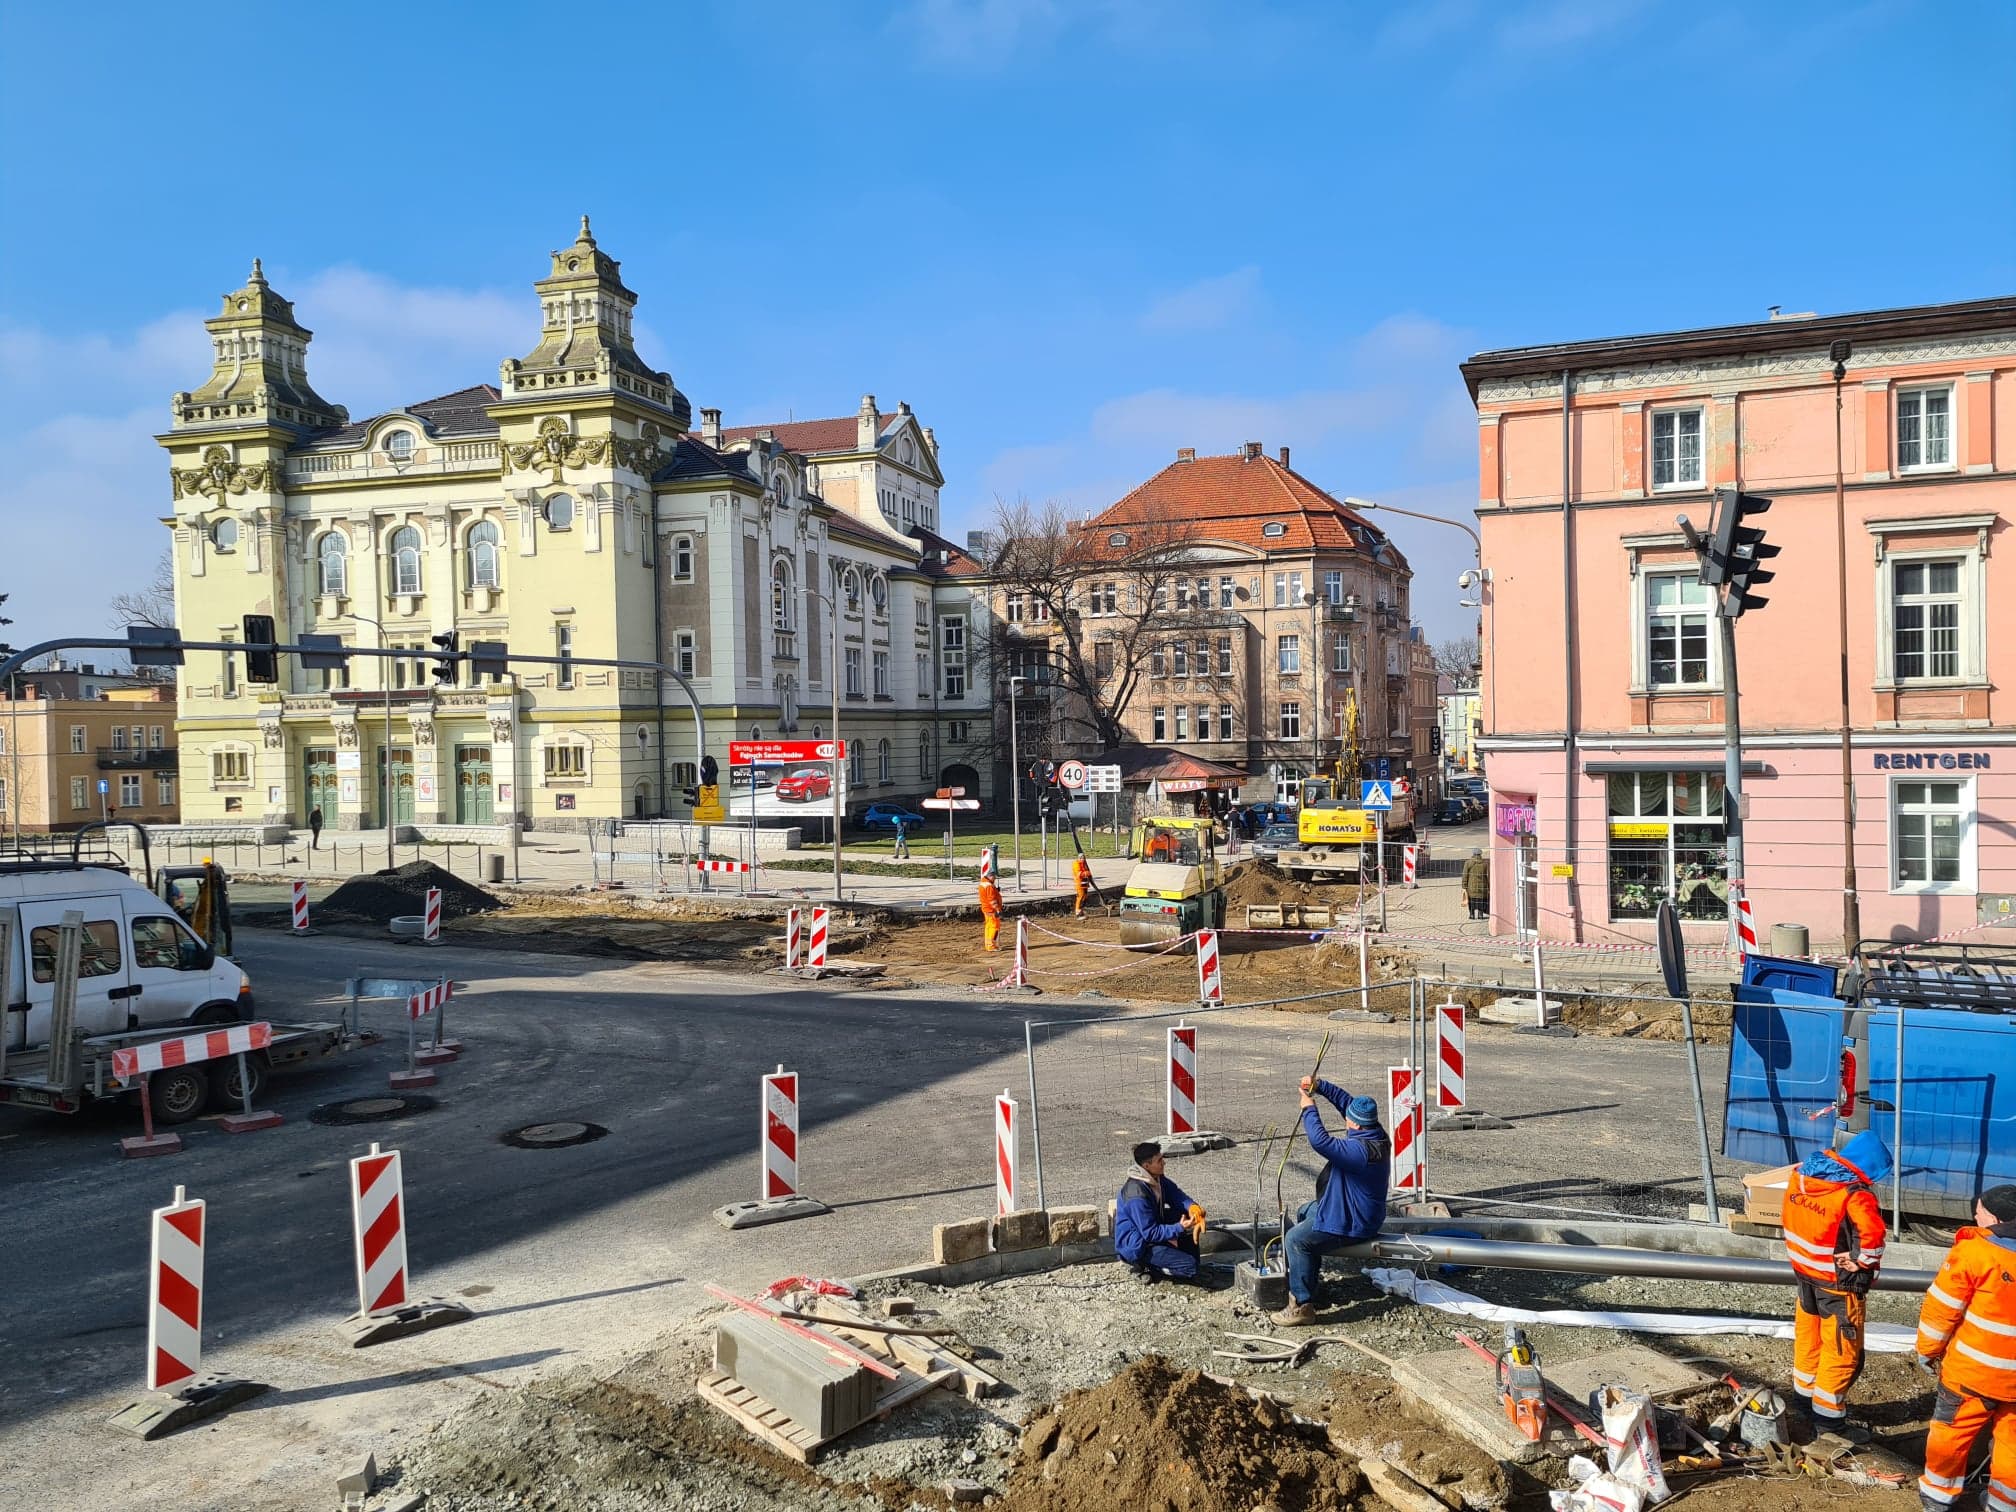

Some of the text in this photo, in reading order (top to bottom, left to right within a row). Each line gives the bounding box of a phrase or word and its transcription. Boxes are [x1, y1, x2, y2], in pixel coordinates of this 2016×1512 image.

[1874, 753, 1991, 769] RENTGEN
[1064, 768, 1082, 781] 40
[1319, 824, 1361, 832] KOMATSU
